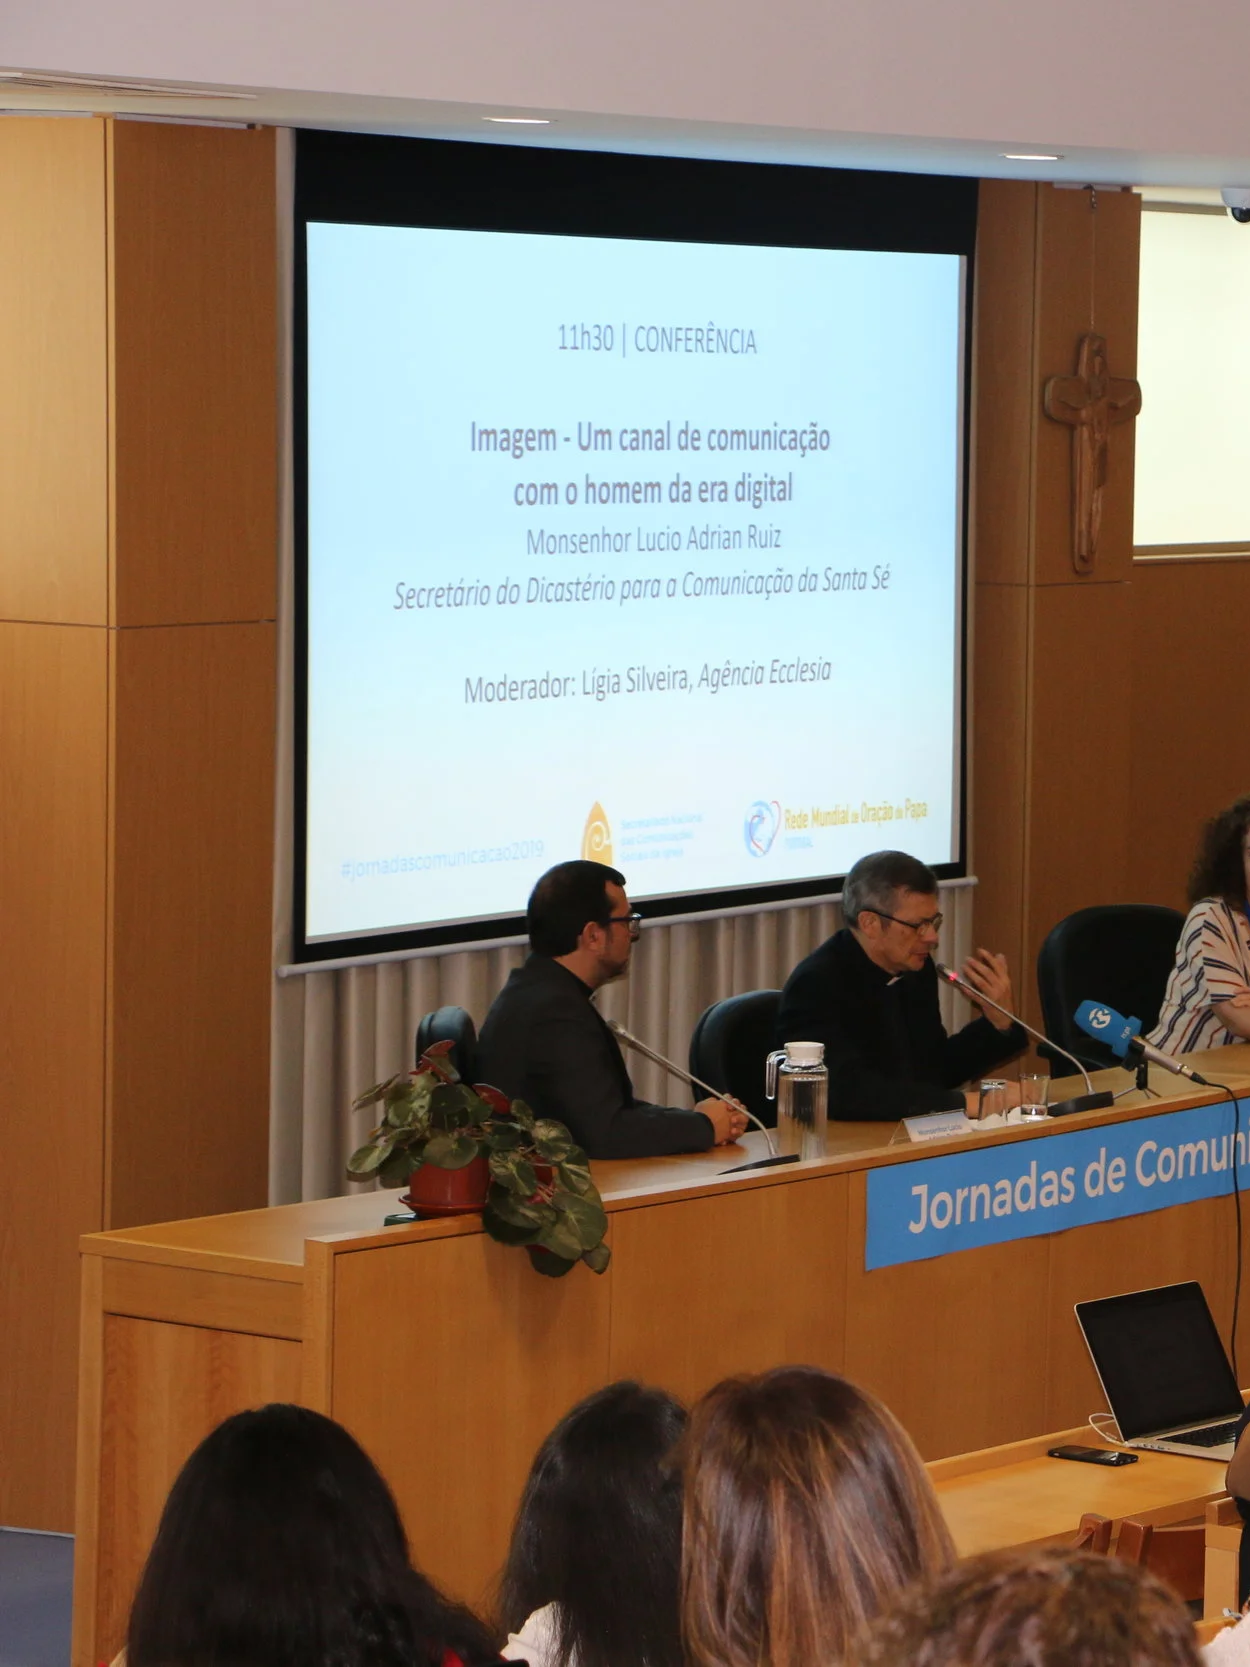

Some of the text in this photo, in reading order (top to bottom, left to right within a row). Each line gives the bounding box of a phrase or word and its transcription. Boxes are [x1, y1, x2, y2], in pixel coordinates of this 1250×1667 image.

[559, 322, 614, 351] 11h30
[635, 321, 757, 354] CONFERÊNCIA
[471, 421, 556, 459] Imagem
[577, 421, 612, 451] Um
[619, 420, 671, 451] canal
[677, 420, 701, 451] de
[707, 421, 830, 458] comunicação
[514, 472, 792, 509] com o homem da era digital
[527, 523, 781, 555] Monsenhor Lucio Adrian Ruiz
[393, 563, 890, 610] Secretário do Dicastério para a Comunicação da Santa Sé
[465, 656, 832, 704] Moderador: Lígia Silveira, Agência Ecclesia
[784, 808, 808, 830] Rede
[811, 803, 849, 828] Mundial
[905, 798, 928, 822] Papa
[908, 1161, 1075, 1234] Jornadas
[1084, 1147, 1125, 1197] de
